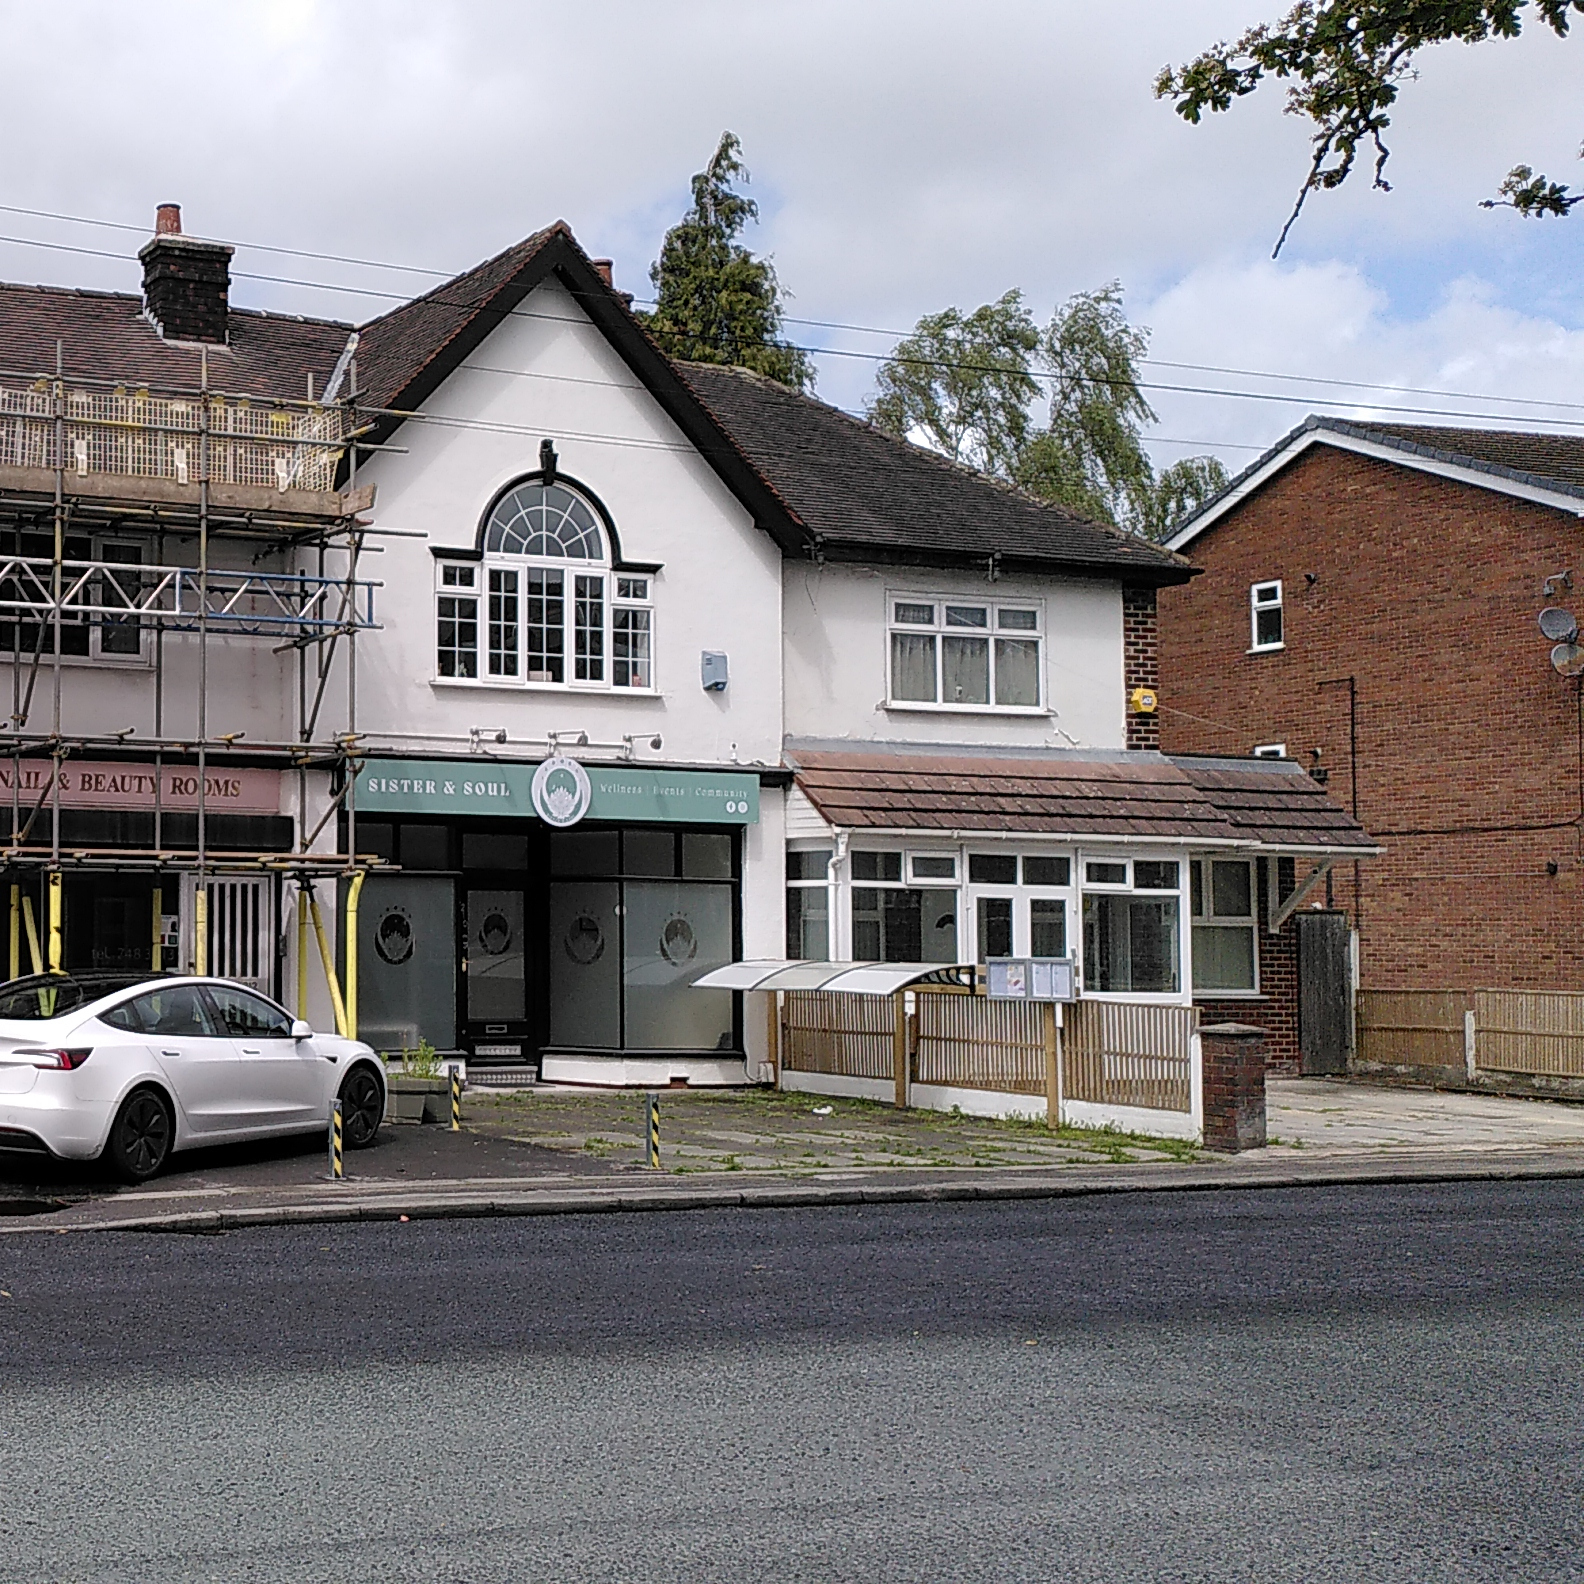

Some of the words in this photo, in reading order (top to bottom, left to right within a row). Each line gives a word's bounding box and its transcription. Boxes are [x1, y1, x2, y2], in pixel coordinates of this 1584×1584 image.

[368, 778, 436, 794] SISTER
[443, 781, 456, 795] &
[463, 782, 510, 796] SOUL
[600, 783, 642, 794] Wellness
[695, 787, 748, 799] Community
